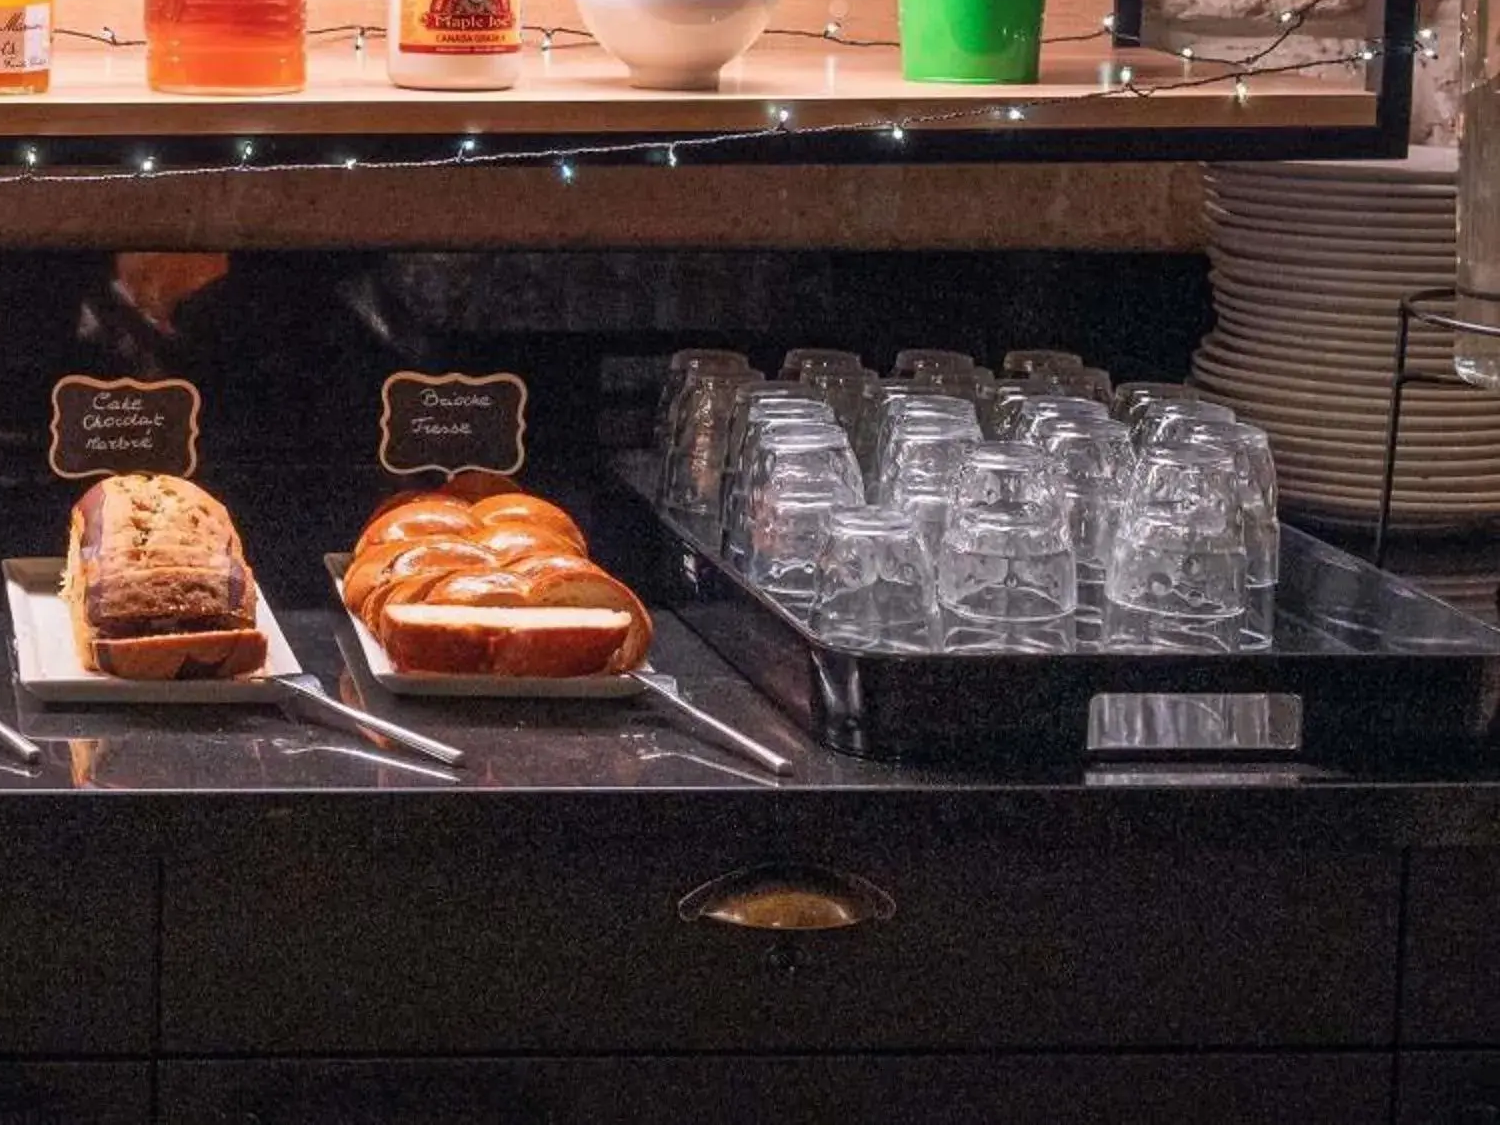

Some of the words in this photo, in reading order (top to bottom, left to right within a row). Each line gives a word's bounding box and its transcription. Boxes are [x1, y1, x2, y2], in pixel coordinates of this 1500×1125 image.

[435, 13, 484, 29] Maple
[92, 392, 145, 410] Cake
[419, 388, 492, 407] Brioche
[83, 413, 165, 430] Chocolat
[411, 416, 472, 434] Tresse
[85, 429, 153, 450] Marbré
